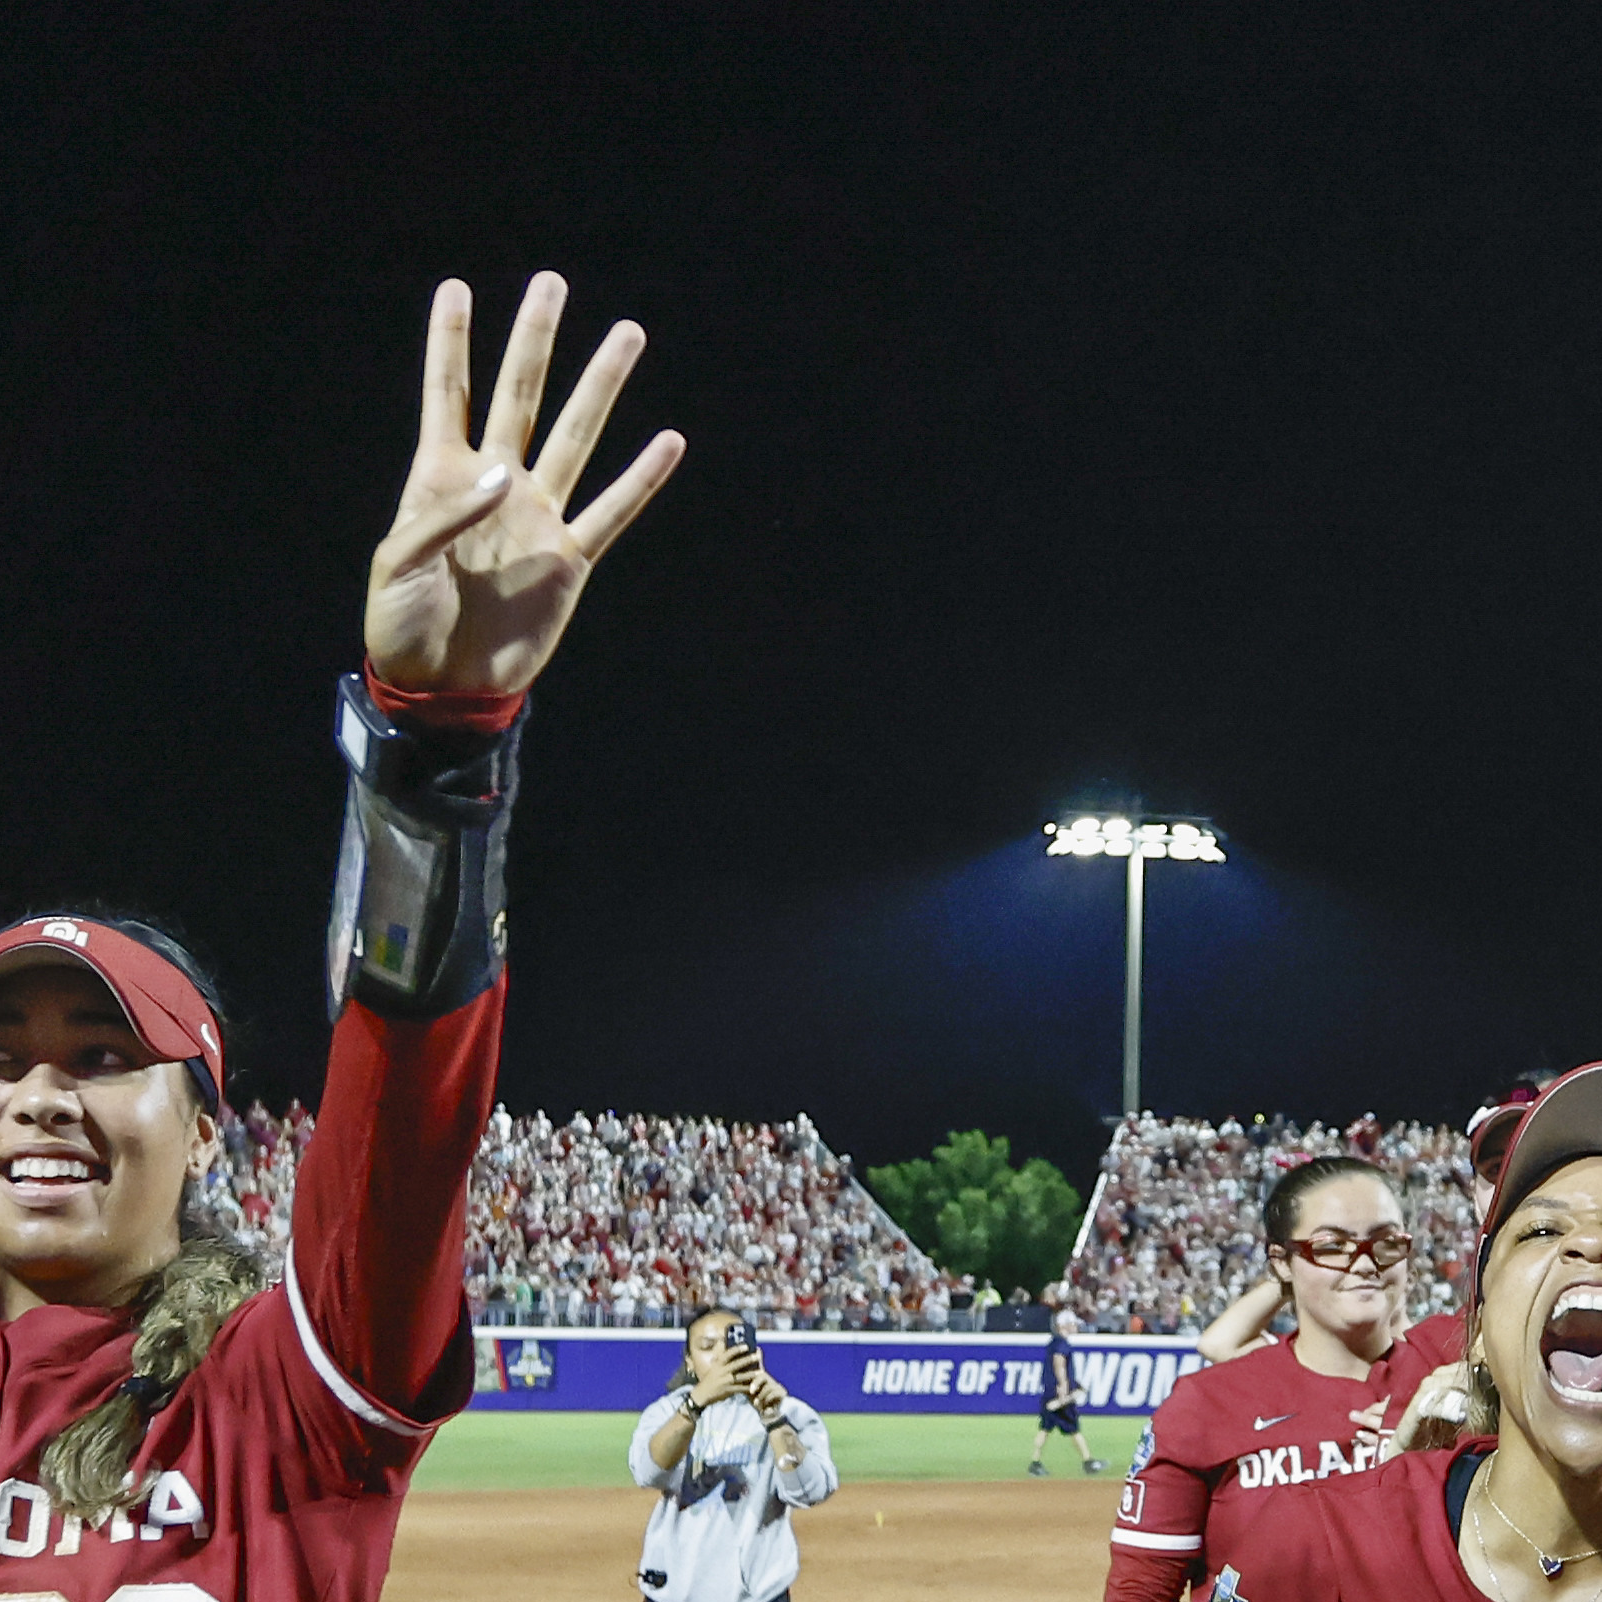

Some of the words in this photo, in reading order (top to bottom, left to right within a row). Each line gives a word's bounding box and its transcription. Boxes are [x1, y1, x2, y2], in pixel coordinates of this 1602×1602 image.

[862, 1359, 953, 1395] HOME
[956, 1360, 1000, 1395] OF
[1003, 1361, 1045, 1395] TH
[1071, 1352, 1209, 1408] WOM
[1237, 1441, 1377, 1488] OKLAH
